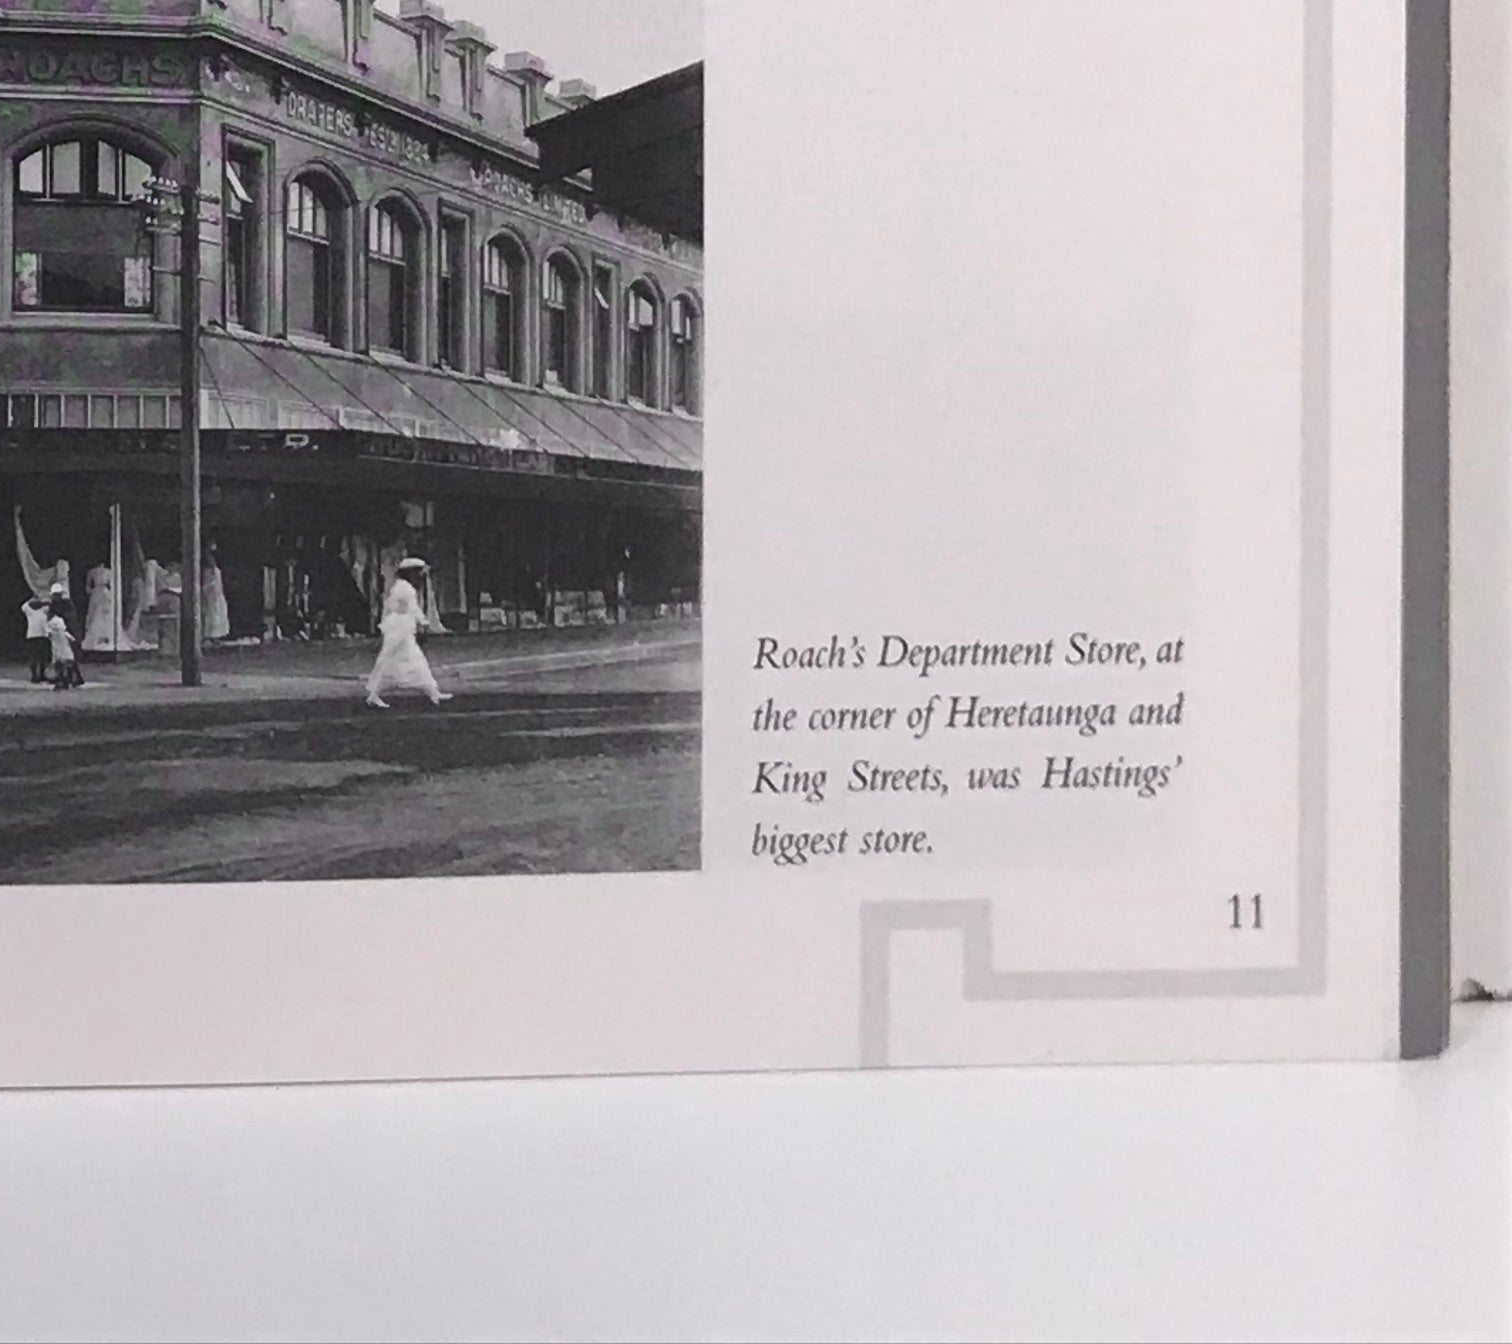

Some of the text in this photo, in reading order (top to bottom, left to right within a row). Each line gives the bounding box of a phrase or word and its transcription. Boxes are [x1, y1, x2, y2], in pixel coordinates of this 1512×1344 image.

[753, 632, 1185, 678] Roach's Department Store, at
[752, 691, 1186, 739] the corner of Heretaunga and
[752, 755, 1183, 804] King Streets, was Hastings'
[751, 822, 933, 867] biggest store.
[1227, 894, 1263, 930] 11
